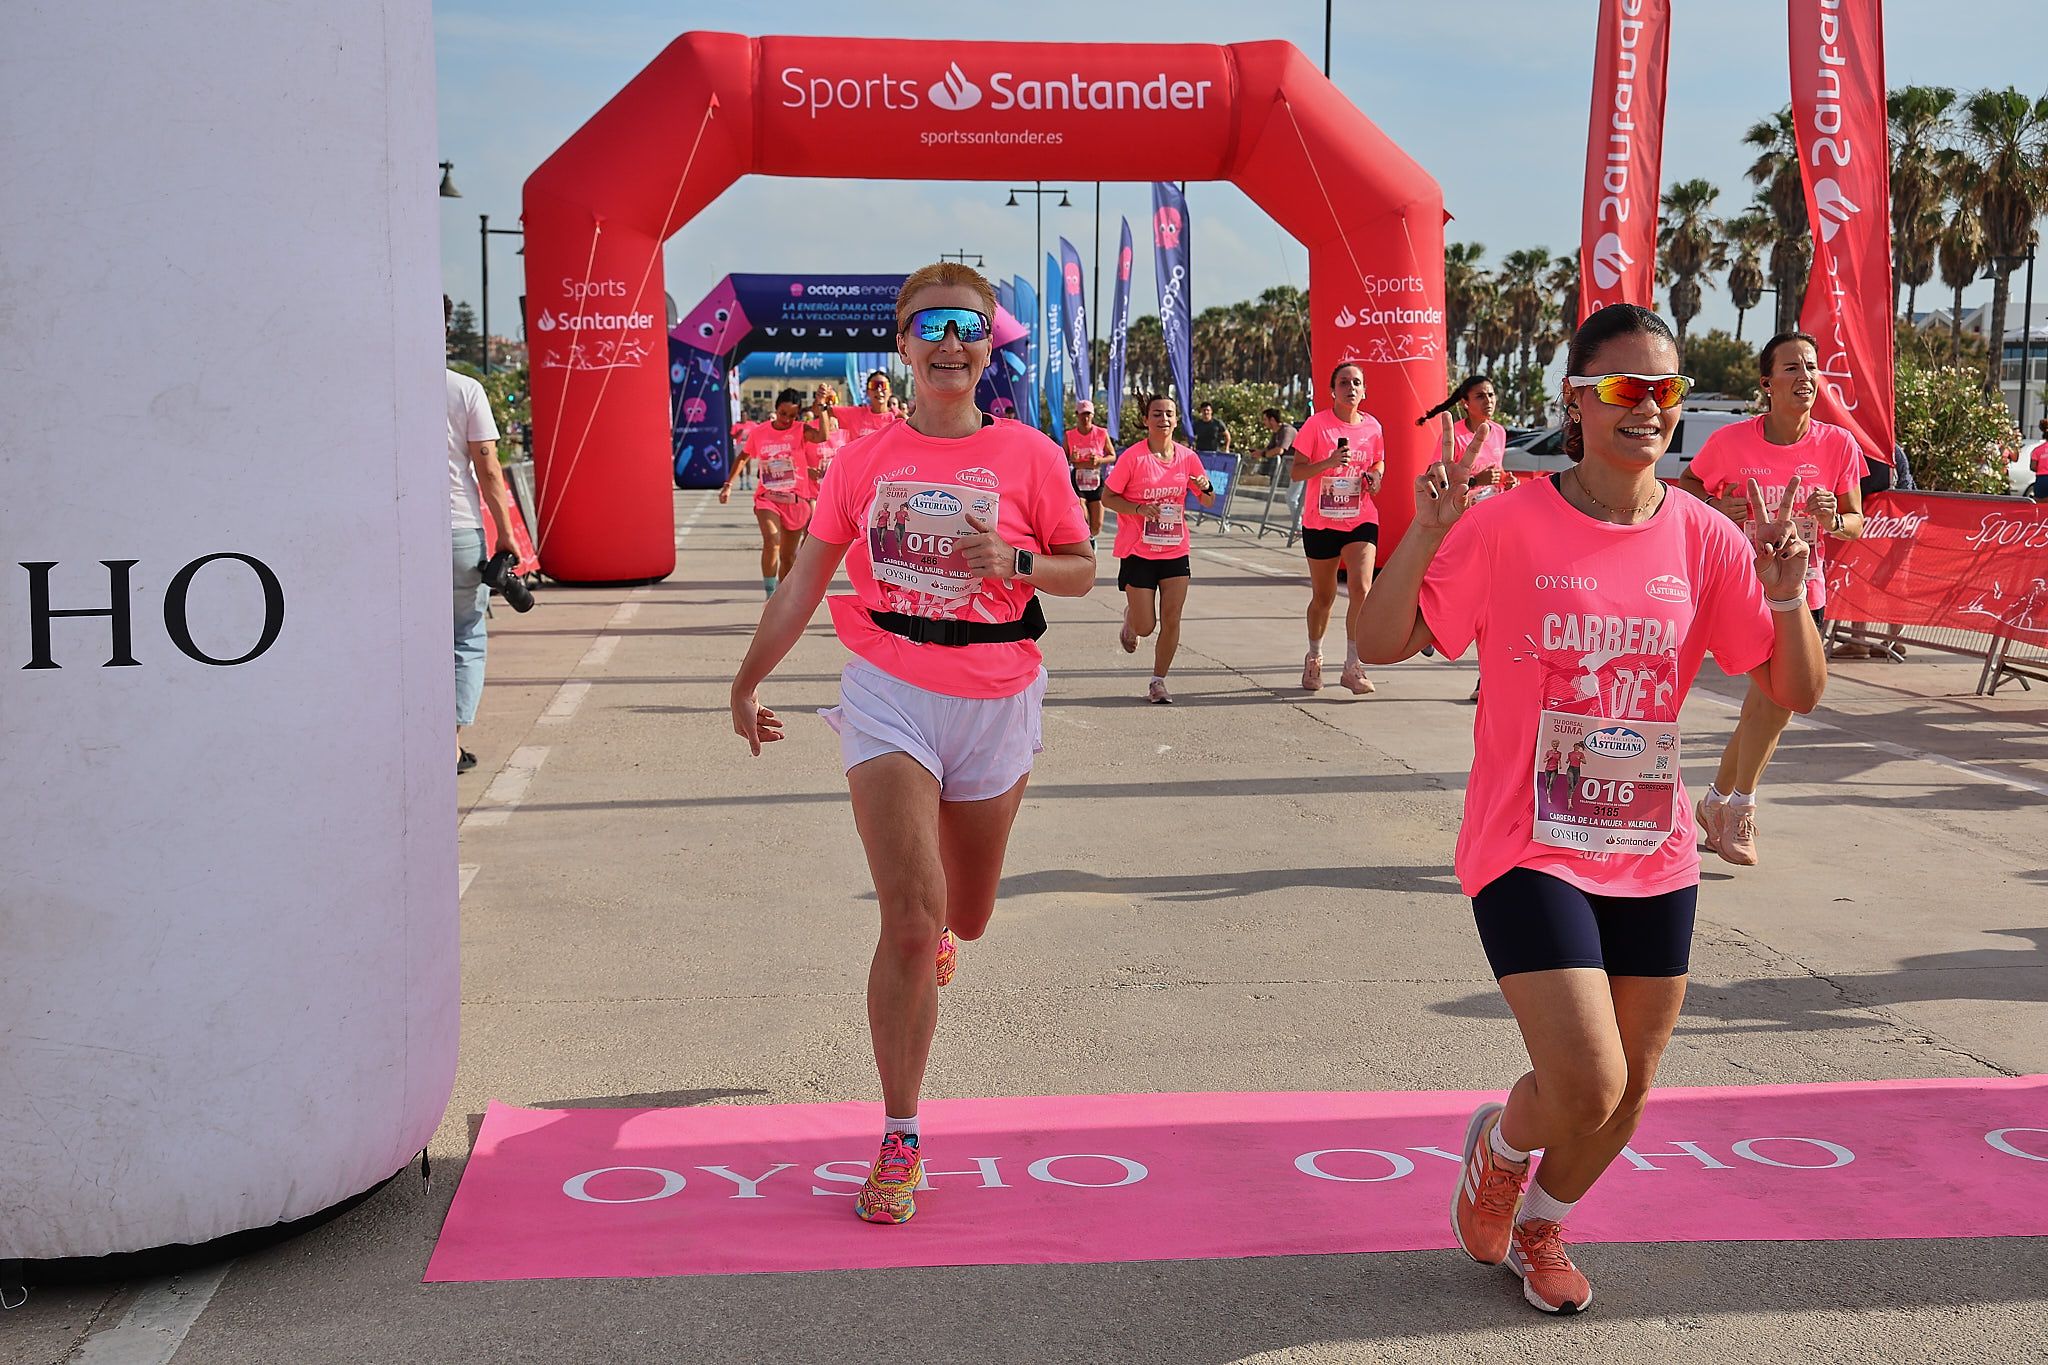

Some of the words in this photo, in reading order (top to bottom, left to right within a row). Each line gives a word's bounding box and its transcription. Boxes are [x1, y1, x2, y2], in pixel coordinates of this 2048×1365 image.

[781, 67, 918, 118] Sports
[990, 72, 1211, 111] Santander
[920, 129, 1063, 146] sportssantander.es
[562, 278, 627, 301] Sports
[807, 284, 860, 298] octopus
[1364, 275, 1424, 297] Sports
[783, 303, 796, 311] LA
[797, 301, 839, 311] ENERGÍA
[841, 303, 868, 311] PARA
[558, 311, 654, 331] Santander
[1360, 306, 1442, 326] Santander
[886, 491, 908, 499] SUMA
[1334, 495, 1350, 503] 016
[912, 498, 958, 512] ASTURIANA
[907, 533, 953, 556] 016
[883, 557, 909, 567] CARRERA
[909, 562, 916, 570] DE
[916, 565, 924, 573] LA
[924, 566, 944, 576] MUJER
[921, 557, 938, 565] 486
[885, 568, 918, 584] OYSHO
[1535, 575, 1598, 591] OYSHO
[940, 582, 971, 593] Santander
[1650, 585, 1688, 598] ASTURIANA
[1542, 613, 1678, 657] CARRERA
[1553, 724, 1583, 736] SUMA
[1589, 735, 1642, 752] ASTURIANA
[1581, 779, 1634, 803] 016
[1593, 806, 1619, 817] 3185
[1549, 812, 1576, 823] CARRERA
[1578, 816, 1587, 824] DE
[1601, 819, 1623, 827] MUJER
[1628, 820, 1658, 829] VALENCIA
[1551, 828, 1589, 843] OYSHO
[1616, 836, 1657, 847] Santander
